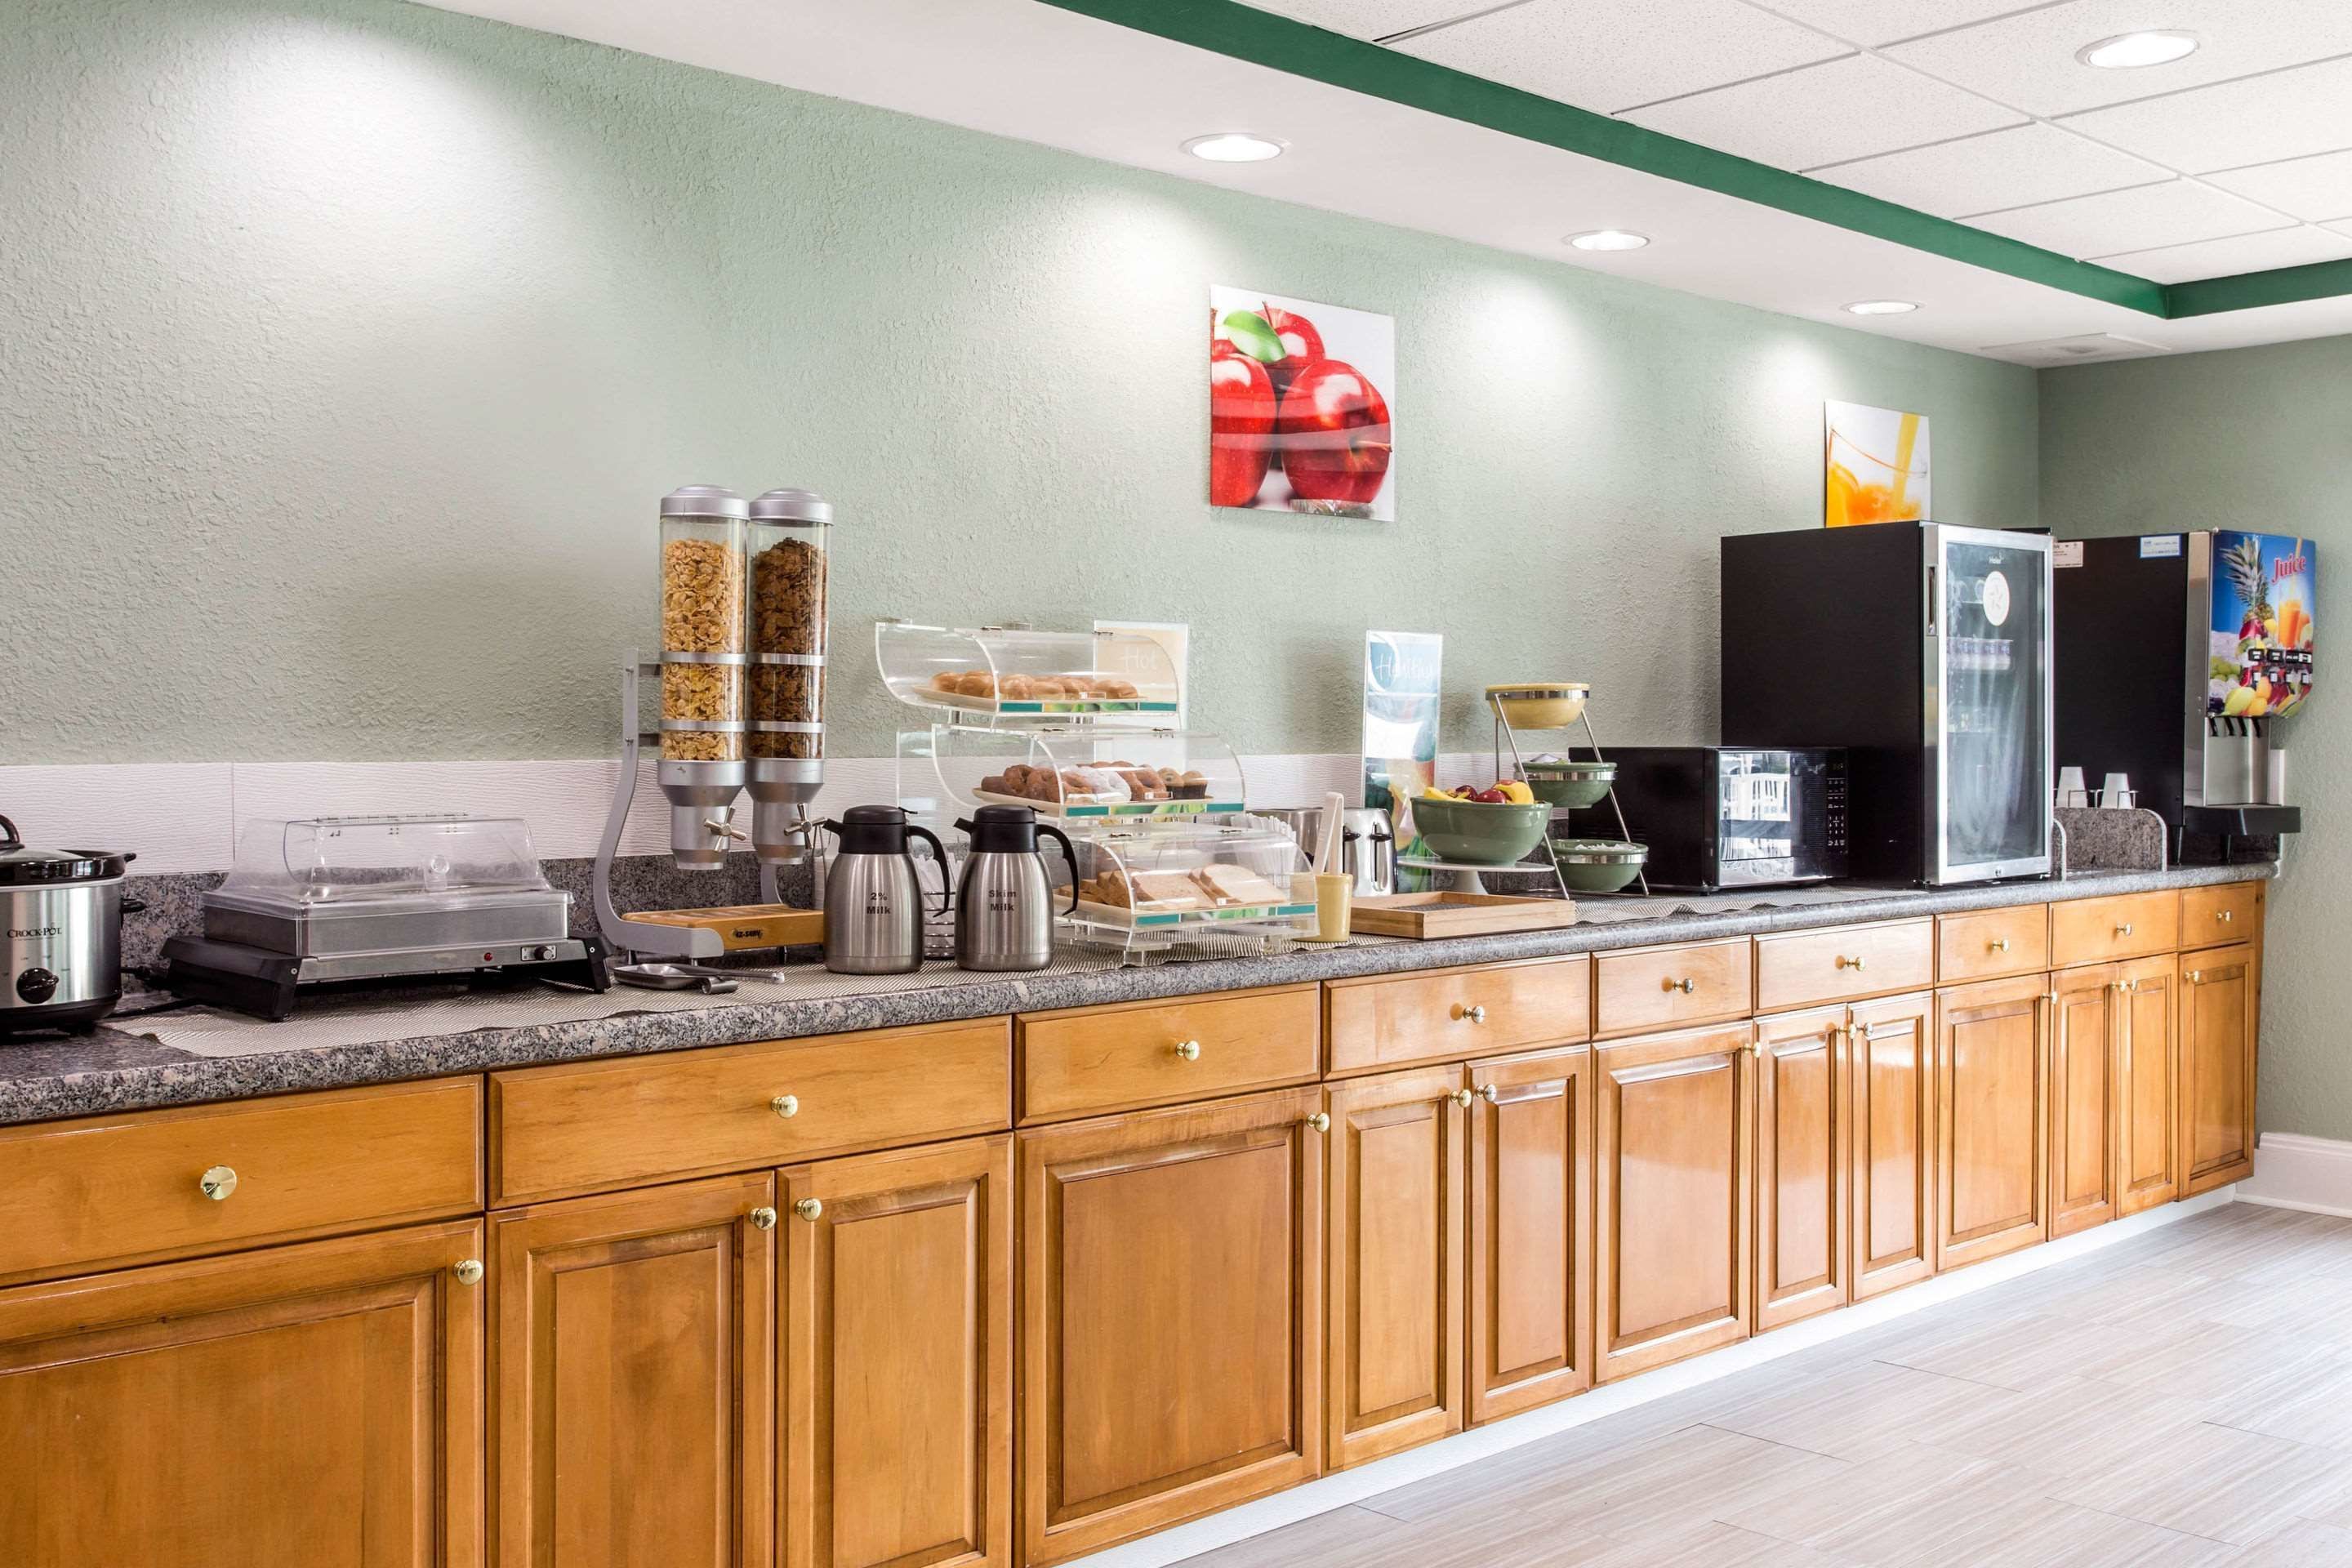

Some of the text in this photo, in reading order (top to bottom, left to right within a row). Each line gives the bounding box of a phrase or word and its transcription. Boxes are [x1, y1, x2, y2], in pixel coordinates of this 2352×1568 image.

[2270, 553, 2306, 586] Juice
[870, 892, 888, 901] 2%
[988, 889, 1017, 898] Skim
[866, 906, 891, 915] Milk
[990, 903, 1014, 911] Milk
